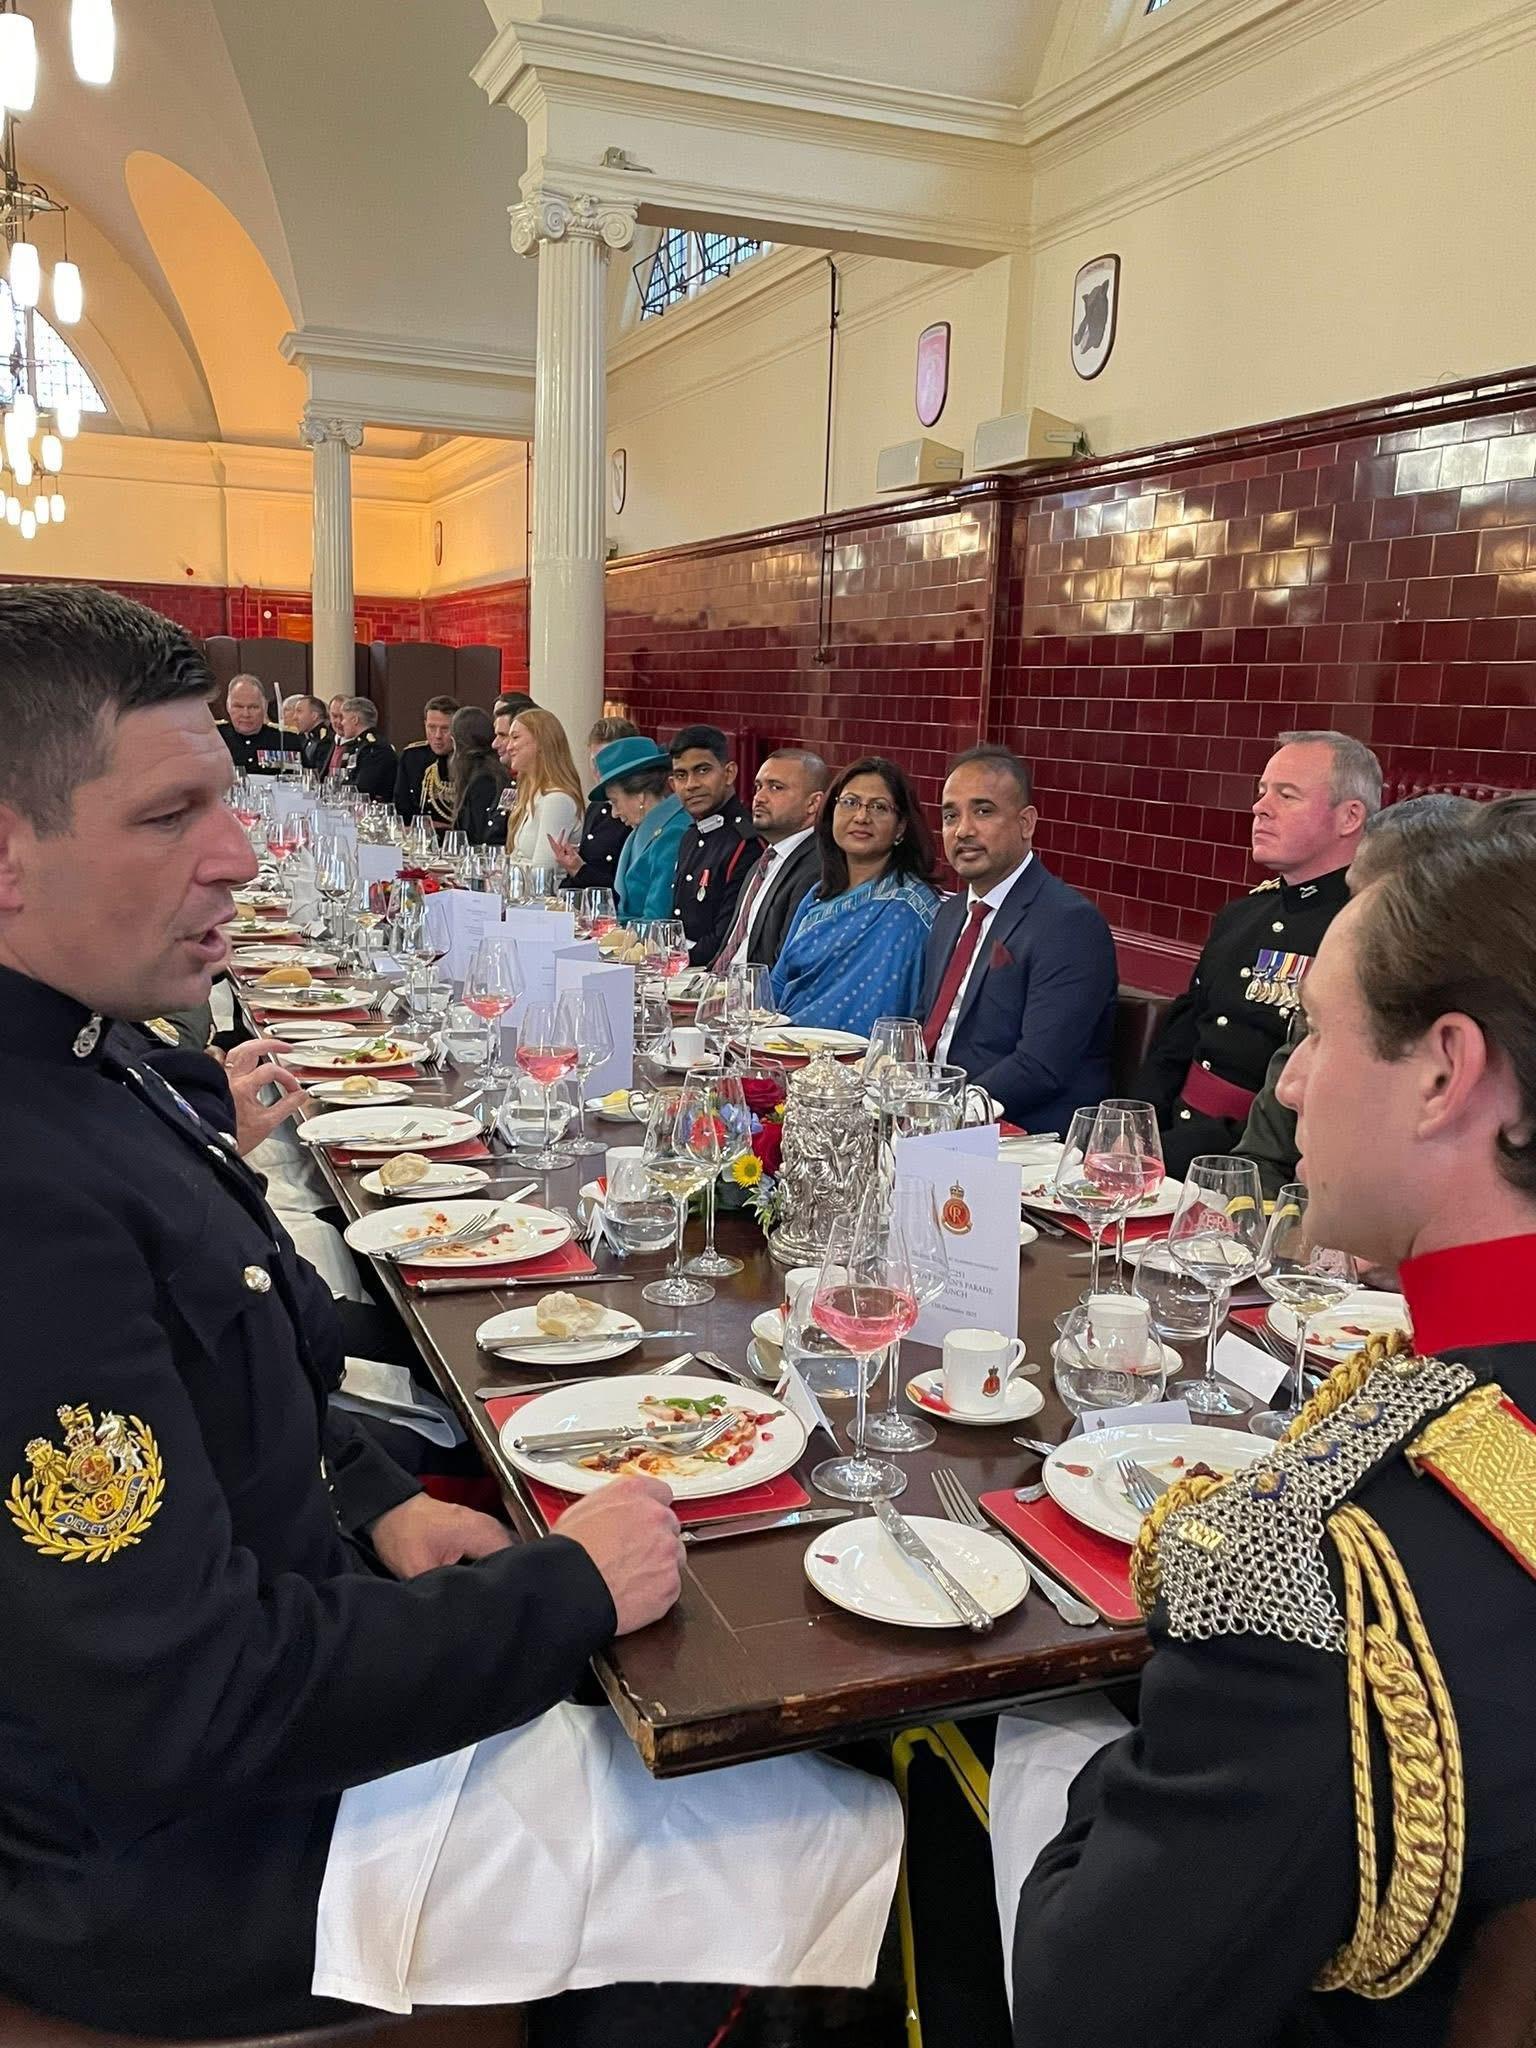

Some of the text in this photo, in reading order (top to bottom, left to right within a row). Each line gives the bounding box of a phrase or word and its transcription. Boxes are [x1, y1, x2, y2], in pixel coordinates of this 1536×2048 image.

[943, 1286, 968, 1299] UNCH
[965, 1281, 993, 1295] PARADE
[64, 1514, 88, 1532] DIEU
[89, 1525, 104, 1536] ET
